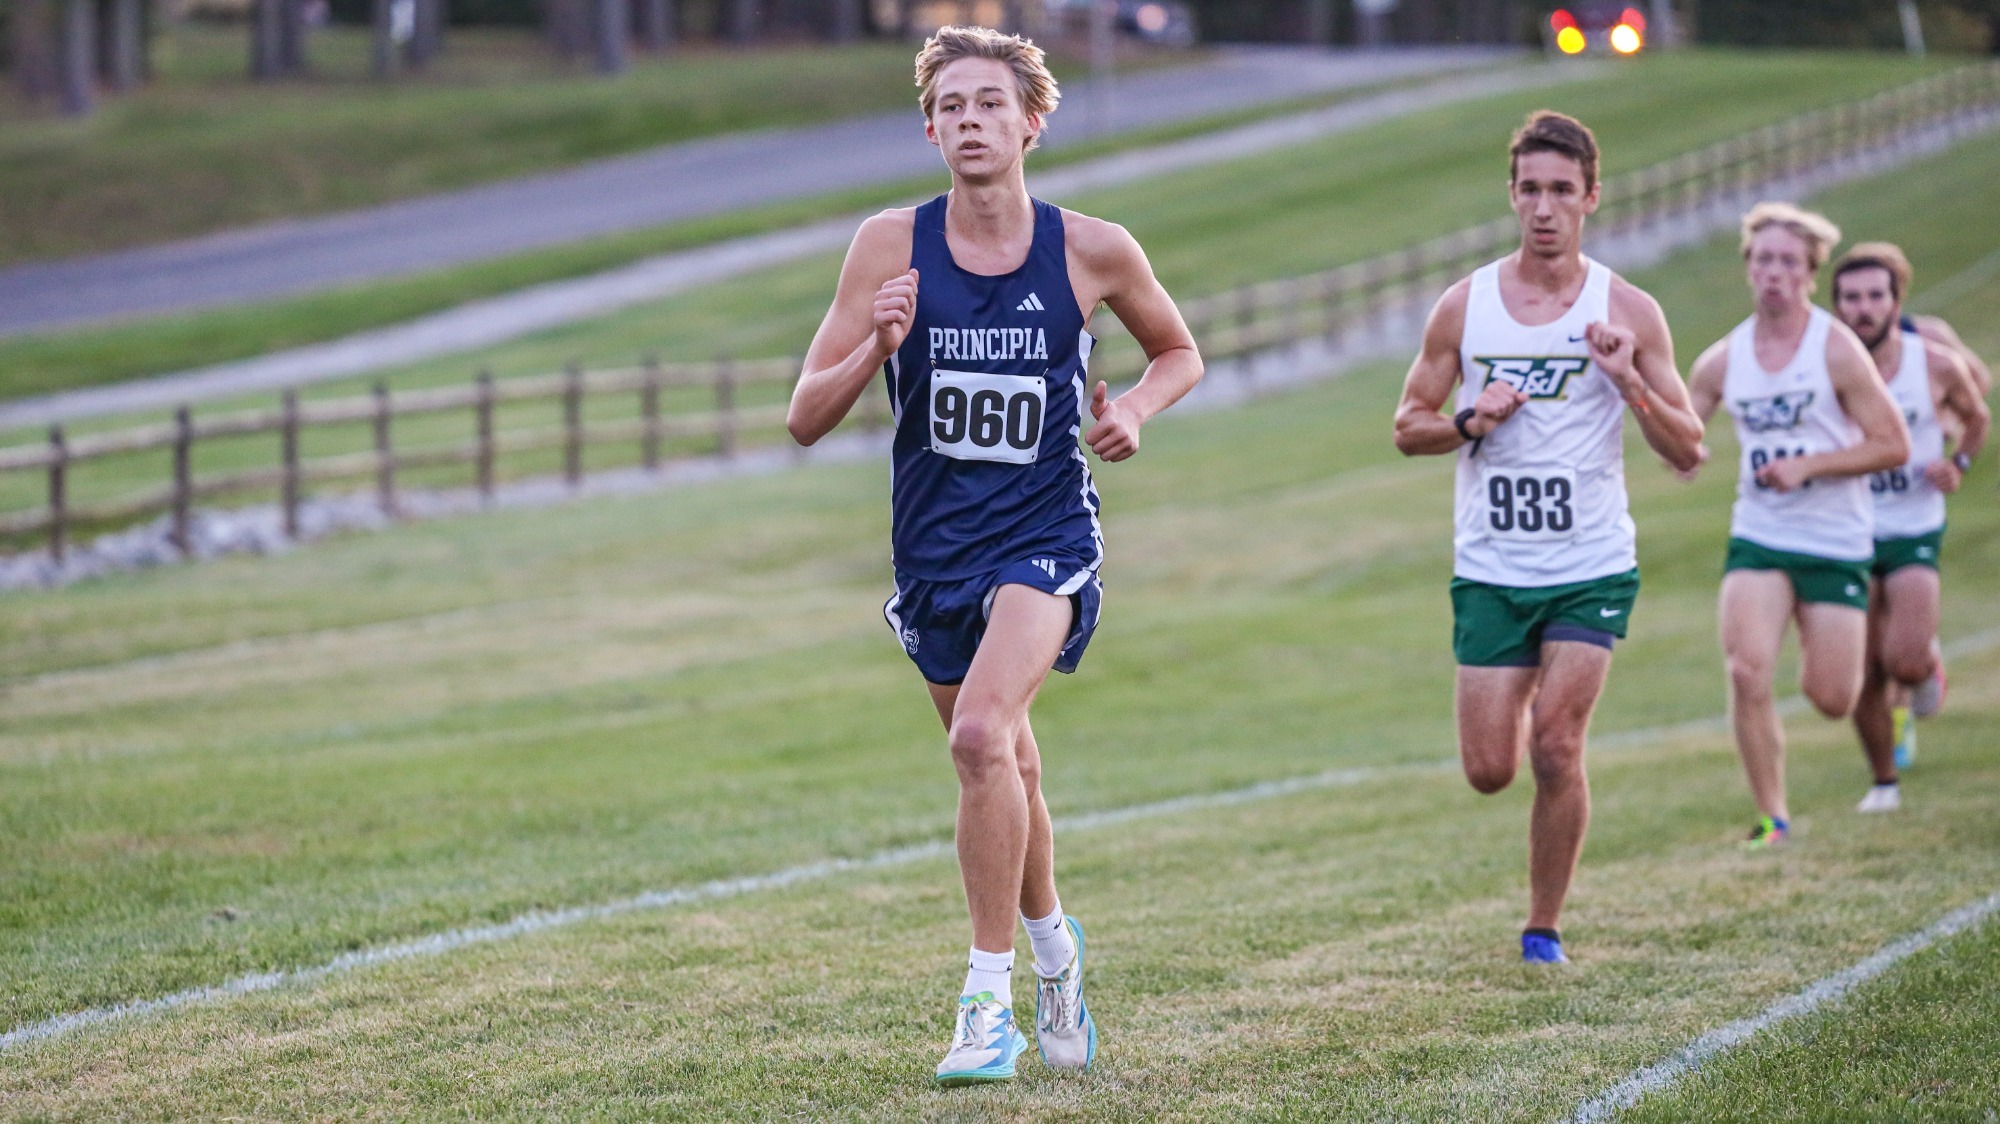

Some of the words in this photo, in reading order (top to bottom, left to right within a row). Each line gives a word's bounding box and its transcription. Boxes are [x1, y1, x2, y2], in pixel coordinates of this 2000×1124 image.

[928, 327, 1048, 360] PRINCIPIA
[1480, 356, 1590, 400] S&T
[933, 386, 1042, 450] 960
[1488, 475, 1573, 533] 933
